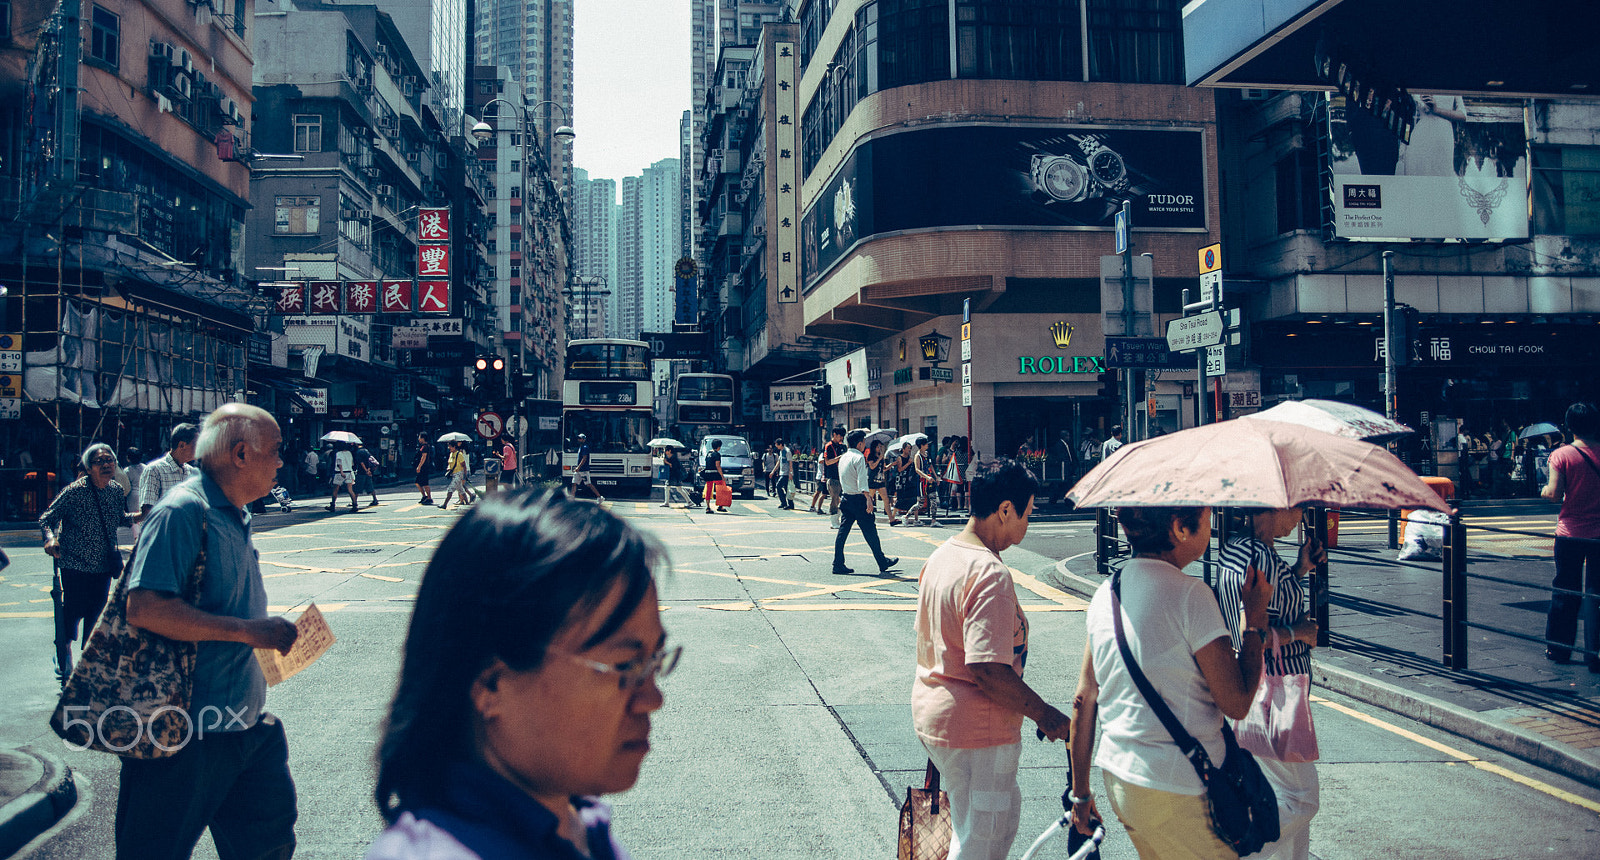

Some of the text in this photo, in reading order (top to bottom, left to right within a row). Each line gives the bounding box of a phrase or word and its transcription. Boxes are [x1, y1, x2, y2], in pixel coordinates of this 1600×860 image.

[1348, 187, 1377, 198] 周大福
[1148, 194, 1194, 205] TUDOR
[421, 211, 448, 274] 港豐
[1212, 274, 1218, 282] 7
[1179, 317, 1208, 331] Sha Tsui Road
[1121, 341, 1145, 350] Tsuen
[1147, 341, 1164, 350] Wan
[1213, 346, 1223, 356] hrs
[1374, 337, 1451, 362] 周福
[1468, 345, 1544, 354] CHOW TAI FOOK
[1019, 356, 1105, 374] ROLEX
[1206, 359, 1221, 373] 全日
[9, 399, 15, 407] 7
[1232, 391, 1259, 406] 潮記
[8, 410, 19, 418] 12
[711, 411, 721, 420] 31
